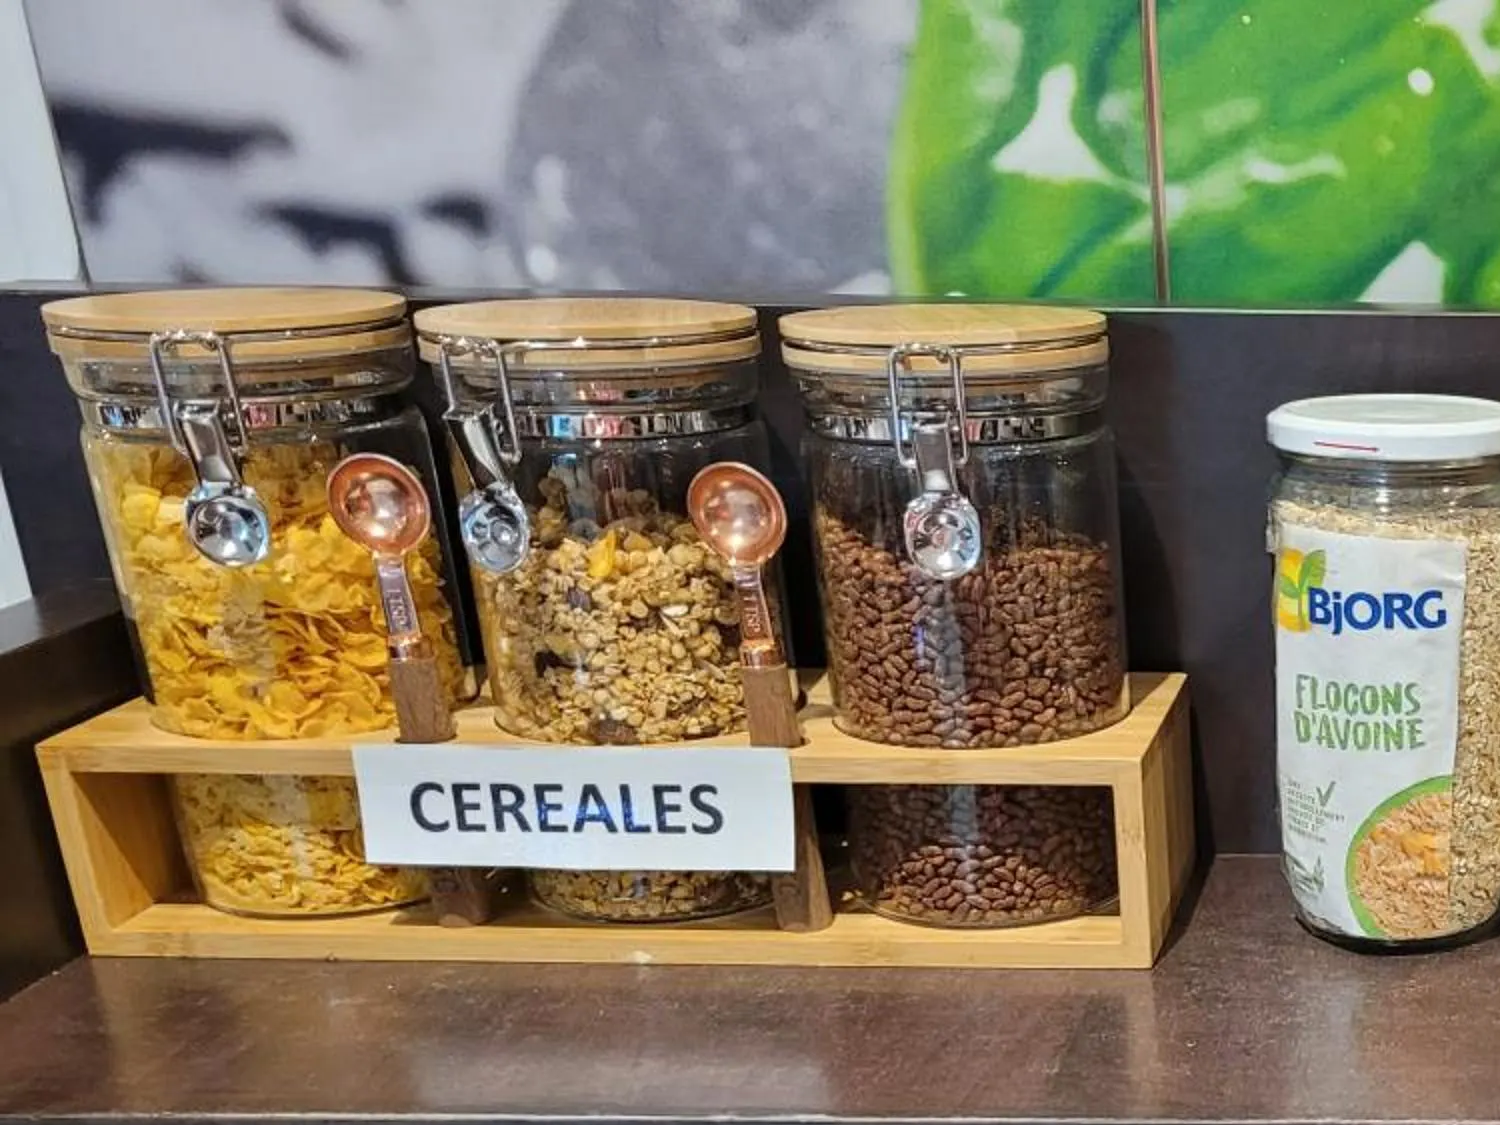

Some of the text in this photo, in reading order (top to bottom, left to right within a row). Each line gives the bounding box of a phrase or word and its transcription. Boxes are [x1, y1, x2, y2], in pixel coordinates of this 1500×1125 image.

[1295, 674, 1422, 717] FLOCONS
[1293, 711, 1427, 752] D'AVOINE
[409, 781, 725, 835] CEREALES
